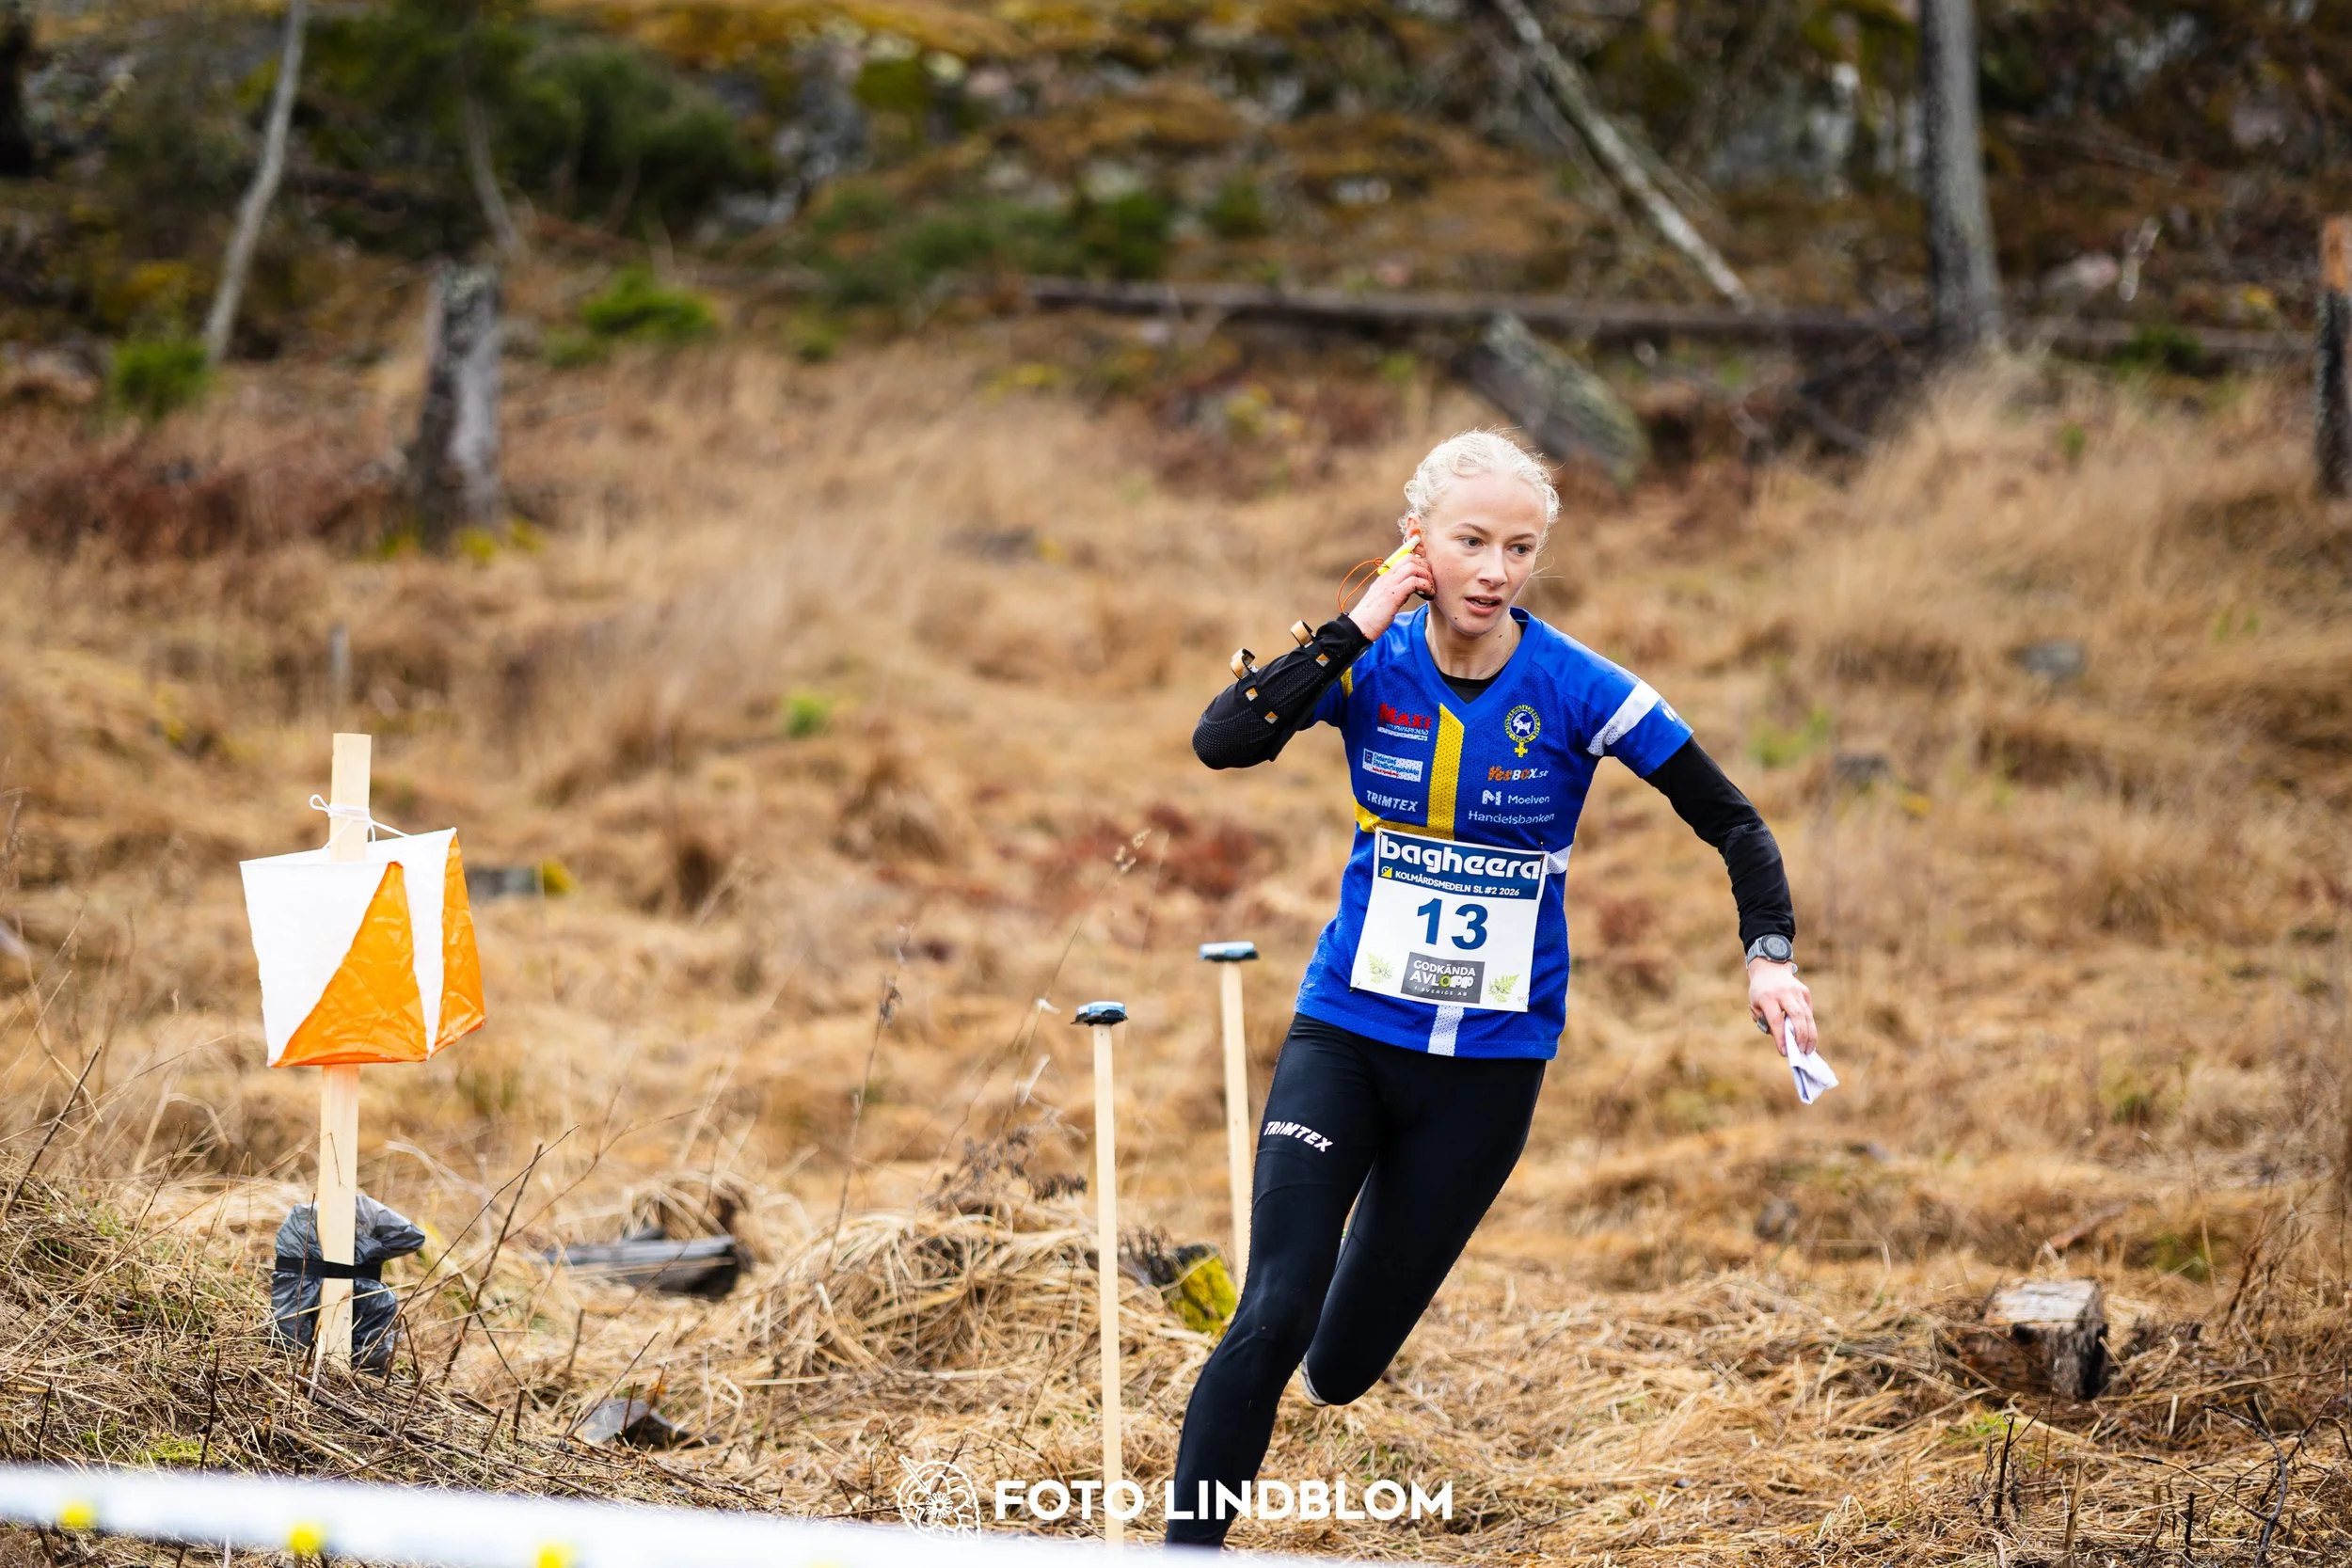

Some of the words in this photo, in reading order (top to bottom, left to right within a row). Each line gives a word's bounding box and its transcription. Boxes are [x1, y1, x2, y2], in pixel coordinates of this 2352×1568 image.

[1378, 703, 1431, 729] MAXI
[1366, 790, 1419, 813] TRIMTEX
[1507, 795, 1550, 804] Moelven
[1468, 810, 1555, 825] Handelsbanken
[1379, 835, 1542, 880] bagheera
[1395, 870, 1471, 893] KOLMÅRDSMEDELN
[1472, 886, 1484, 895] SL
[1484, 887, 1498, 895] #2
[1500, 887, 1520, 896] 2026
[1417, 897, 1488, 950] 13
[1413, 959, 1476, 976] GODKÄNDA
[1408, 970, 1474, 990] AVLOPP
[1263, 1121, 1333, 1152] TRIMTEX
